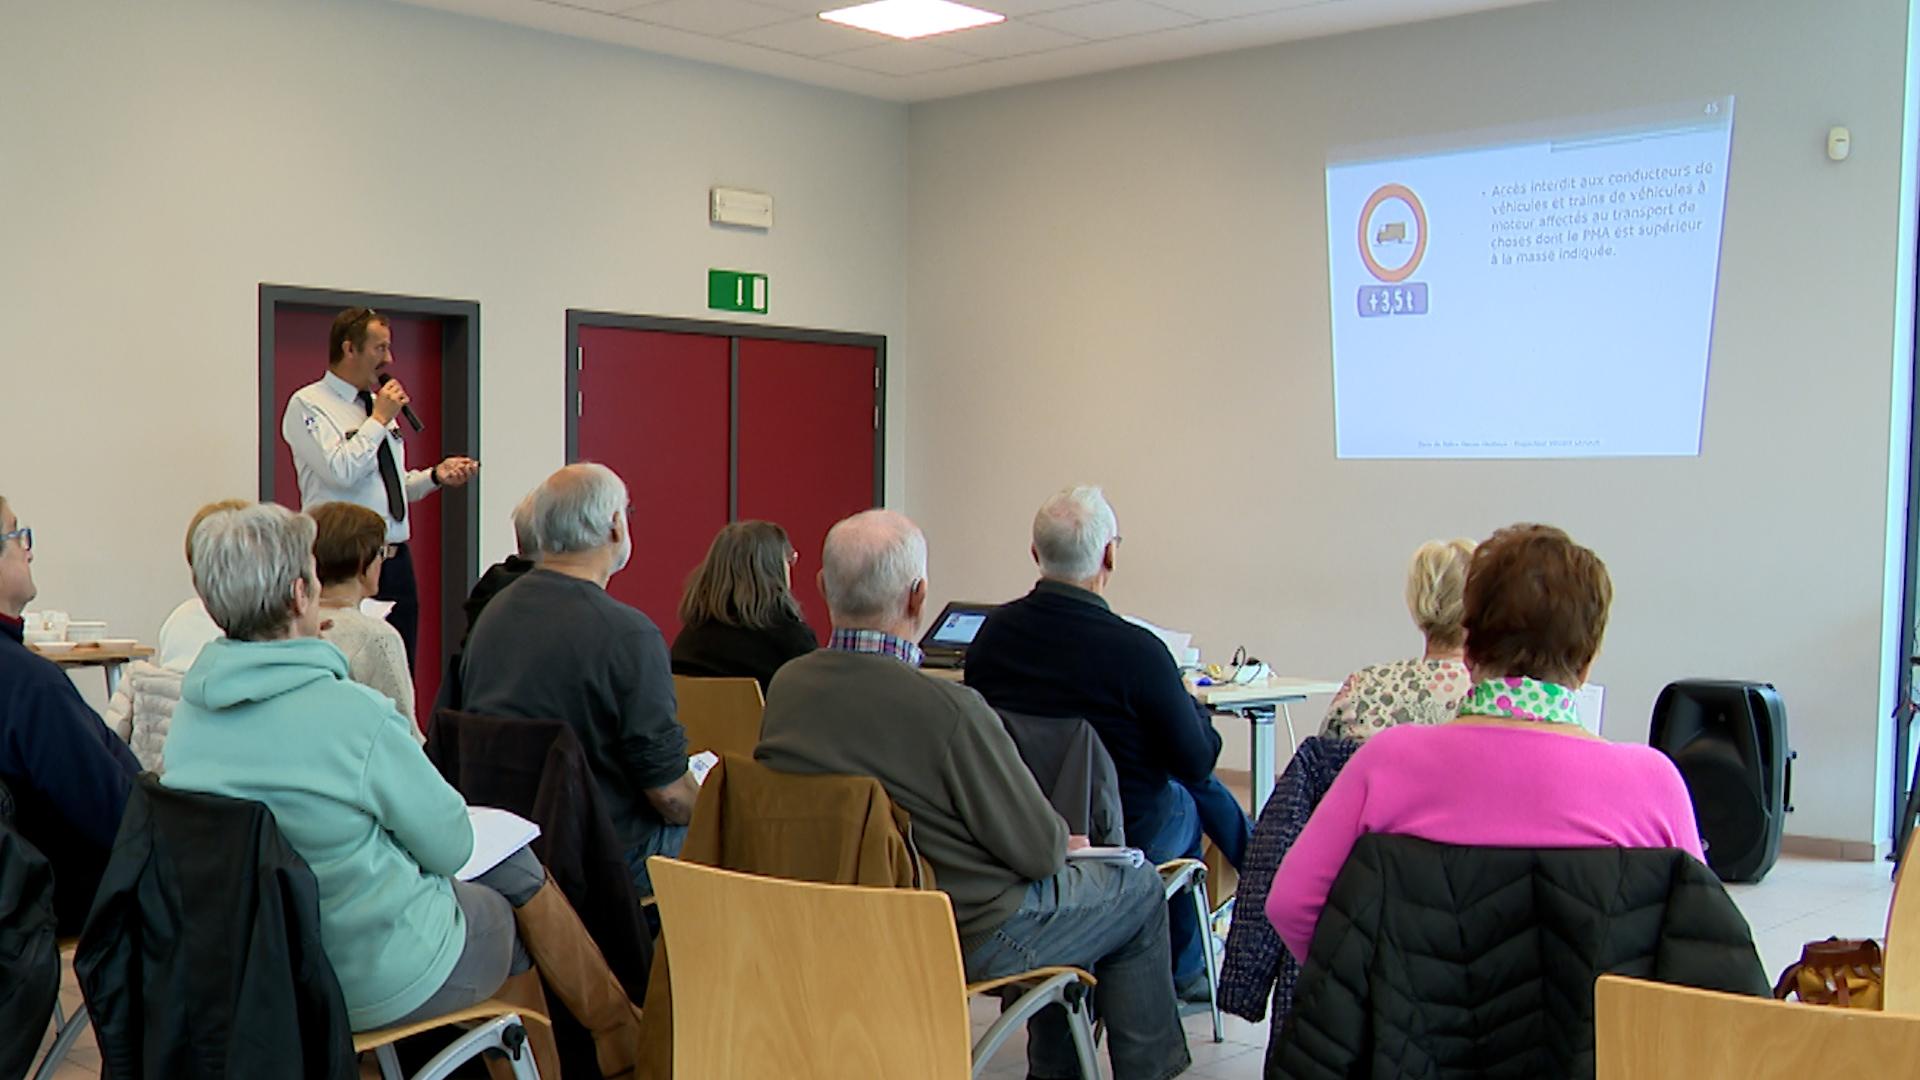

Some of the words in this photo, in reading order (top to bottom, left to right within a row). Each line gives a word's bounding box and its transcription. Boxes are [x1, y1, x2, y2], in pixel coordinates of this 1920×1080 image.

[1704, 103, 1719, 116] 45
[1492, 182, 1526, 197] Accès
[1531, 178, 1576, 193] interdit
[1580, 176, 1604, 189] aux
[1608, 165, 1691, 185] conducteurs
[1695, 160, 1713, 175] de
[1492, 199, 1549, 215] véhicules
[1552, 197, 1565, 210] et
[1569, 192, 1605, 208] trains
[1609, 189, 1626, 204] de
[1630, 183, 1692, 201] véhicules
[1698, 179, 1706, 194] à
[1492, 219, 1534, 232] moteur
[1539, 211, 1588, 227] affectés
[1592, 211, 1609, 225] au
[1613, 203, 1673, 221] transport
[1678, 201, 1695, 215] de
[1491, 235, 1532, 249] choses
[1536, 232, 1563, 245] dont
[1568, 229, 1579, 242] le
[1583, 226, 1610, 242] PMA
[1615, 225, 1634, 239] est
[1638, 220, 1702, 238] supérieur
[1491, 252, 1499, 265] à
[1502, 252, 1513, 265] la
[1517, 249, 1555, 263] masse
[1559, 243, 1616, 260] indiquée.
